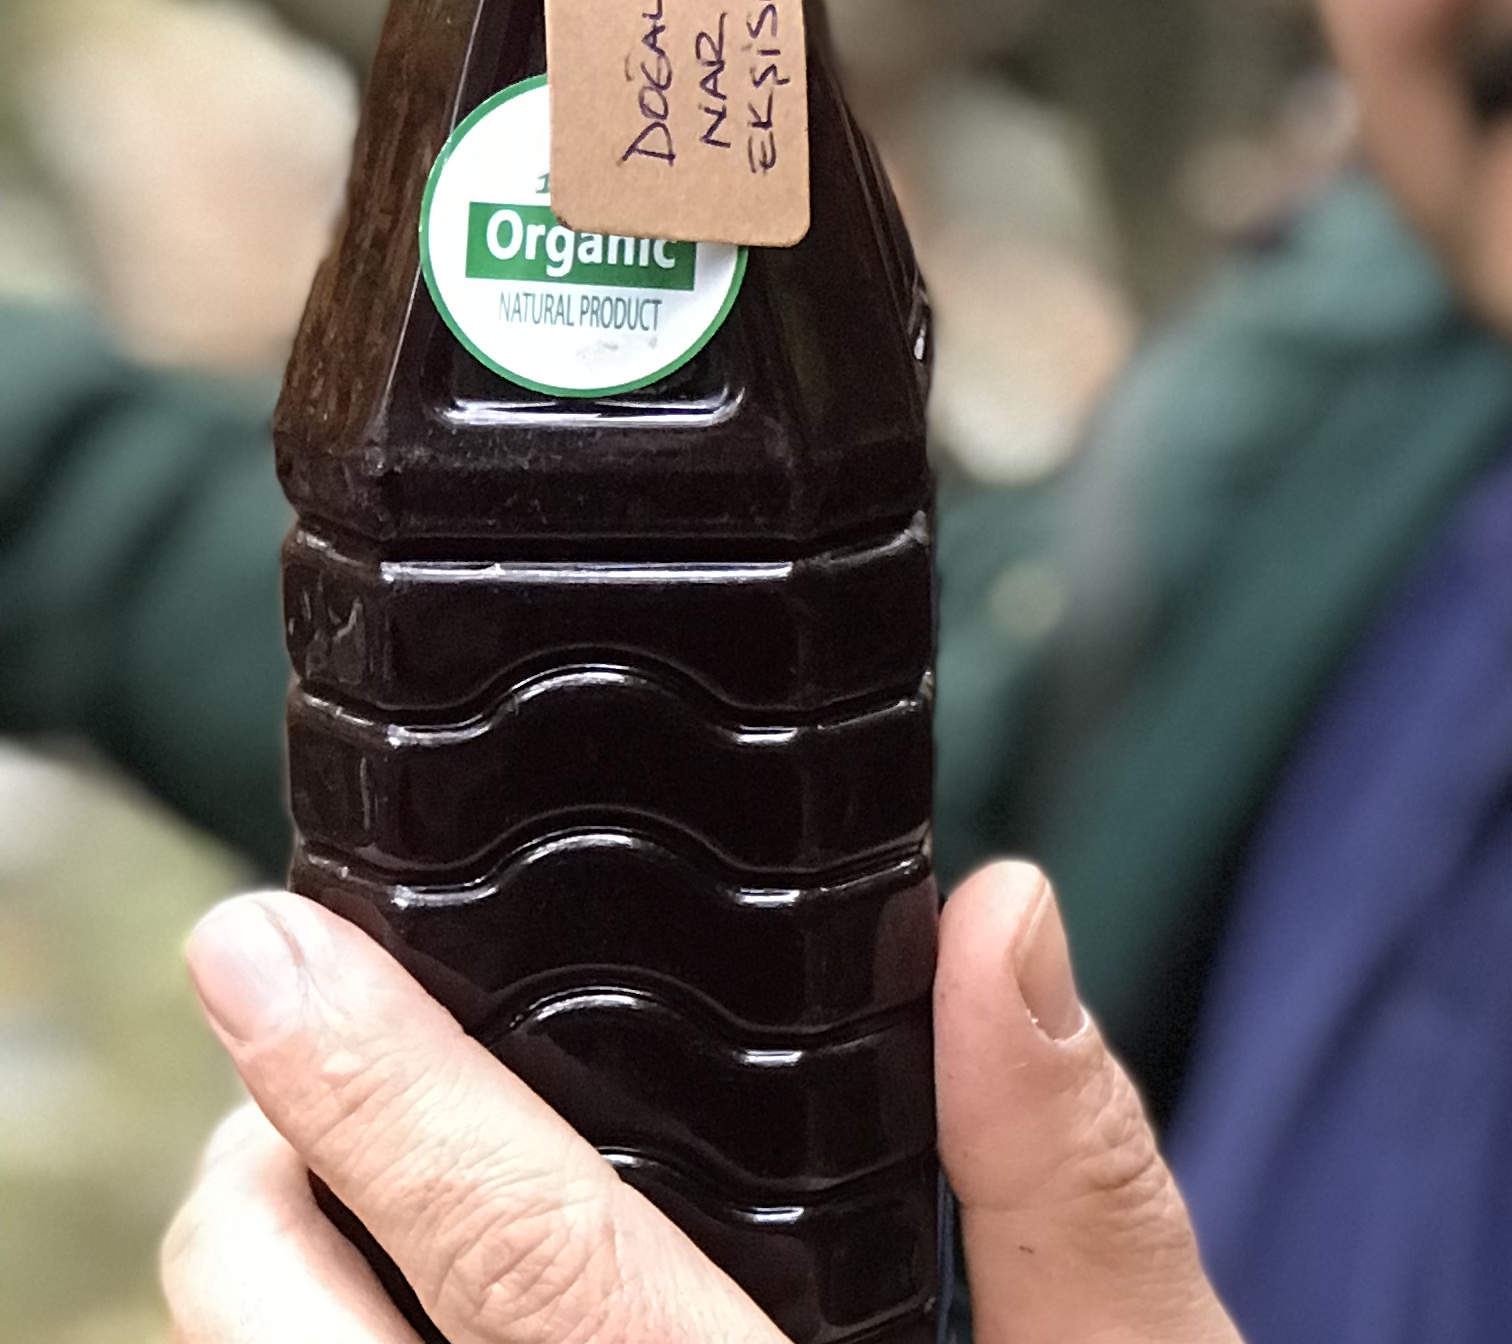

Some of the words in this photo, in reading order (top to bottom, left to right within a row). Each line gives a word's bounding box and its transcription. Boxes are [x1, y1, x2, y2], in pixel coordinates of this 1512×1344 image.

[695, 11, 732, 149] NAR
[485, 208, 678, 278] Organic
[499, 291, 575, 327] NATURAL
[579, 294, 663, 332] PRODUCT
